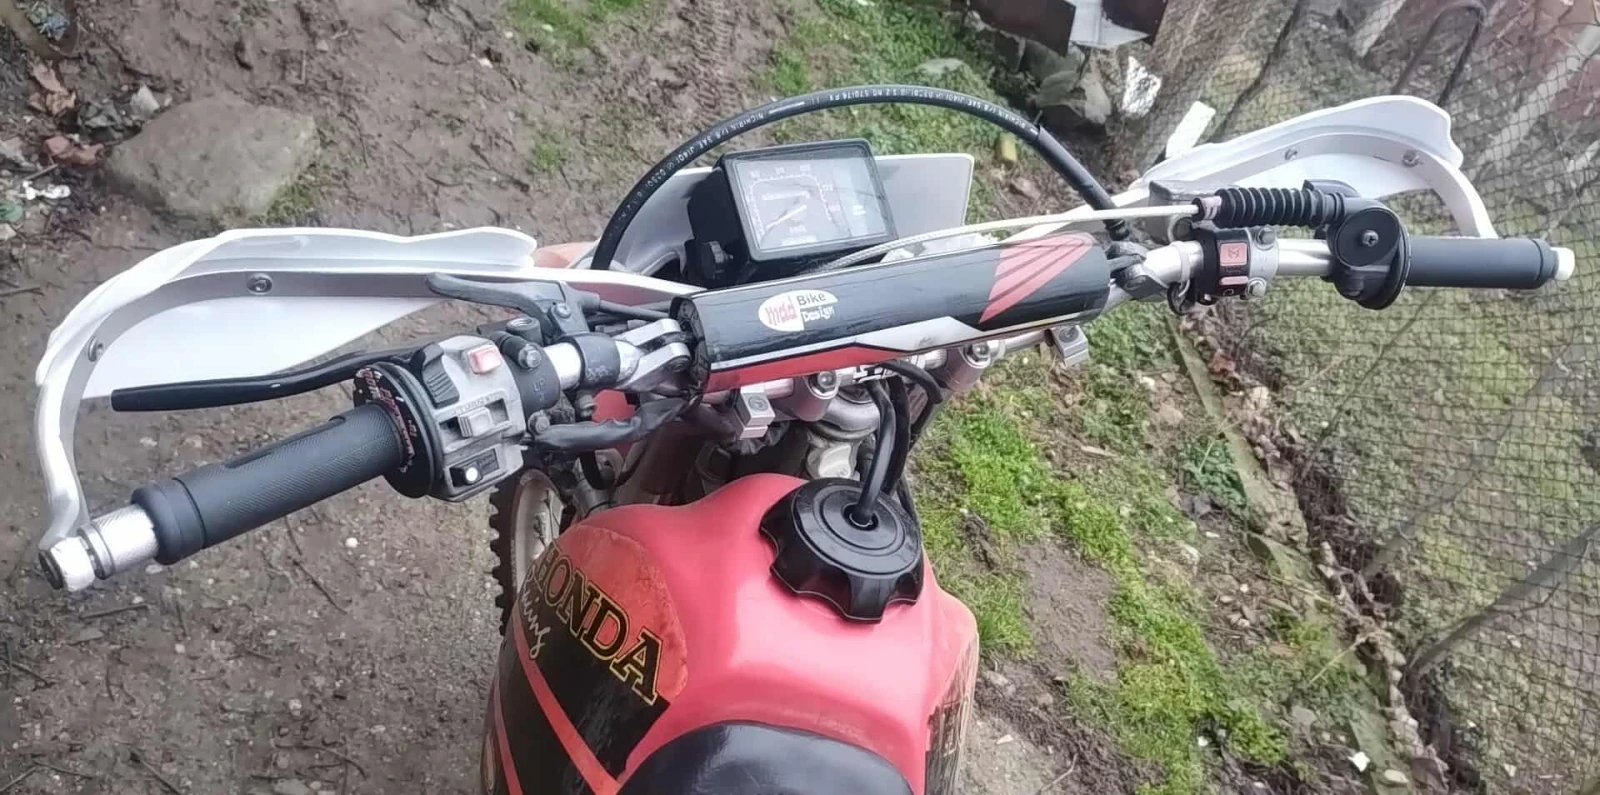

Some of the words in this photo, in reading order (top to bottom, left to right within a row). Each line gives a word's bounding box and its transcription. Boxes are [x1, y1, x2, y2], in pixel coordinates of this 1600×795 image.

[965, 97, 982, 109] SAE
[730, 112, 764, 132] NICHIRIN
[697, 135, 713, 148] SAE
[797, 293, 826, 306] Bike
[537, 540, 664, 707] HONDA
